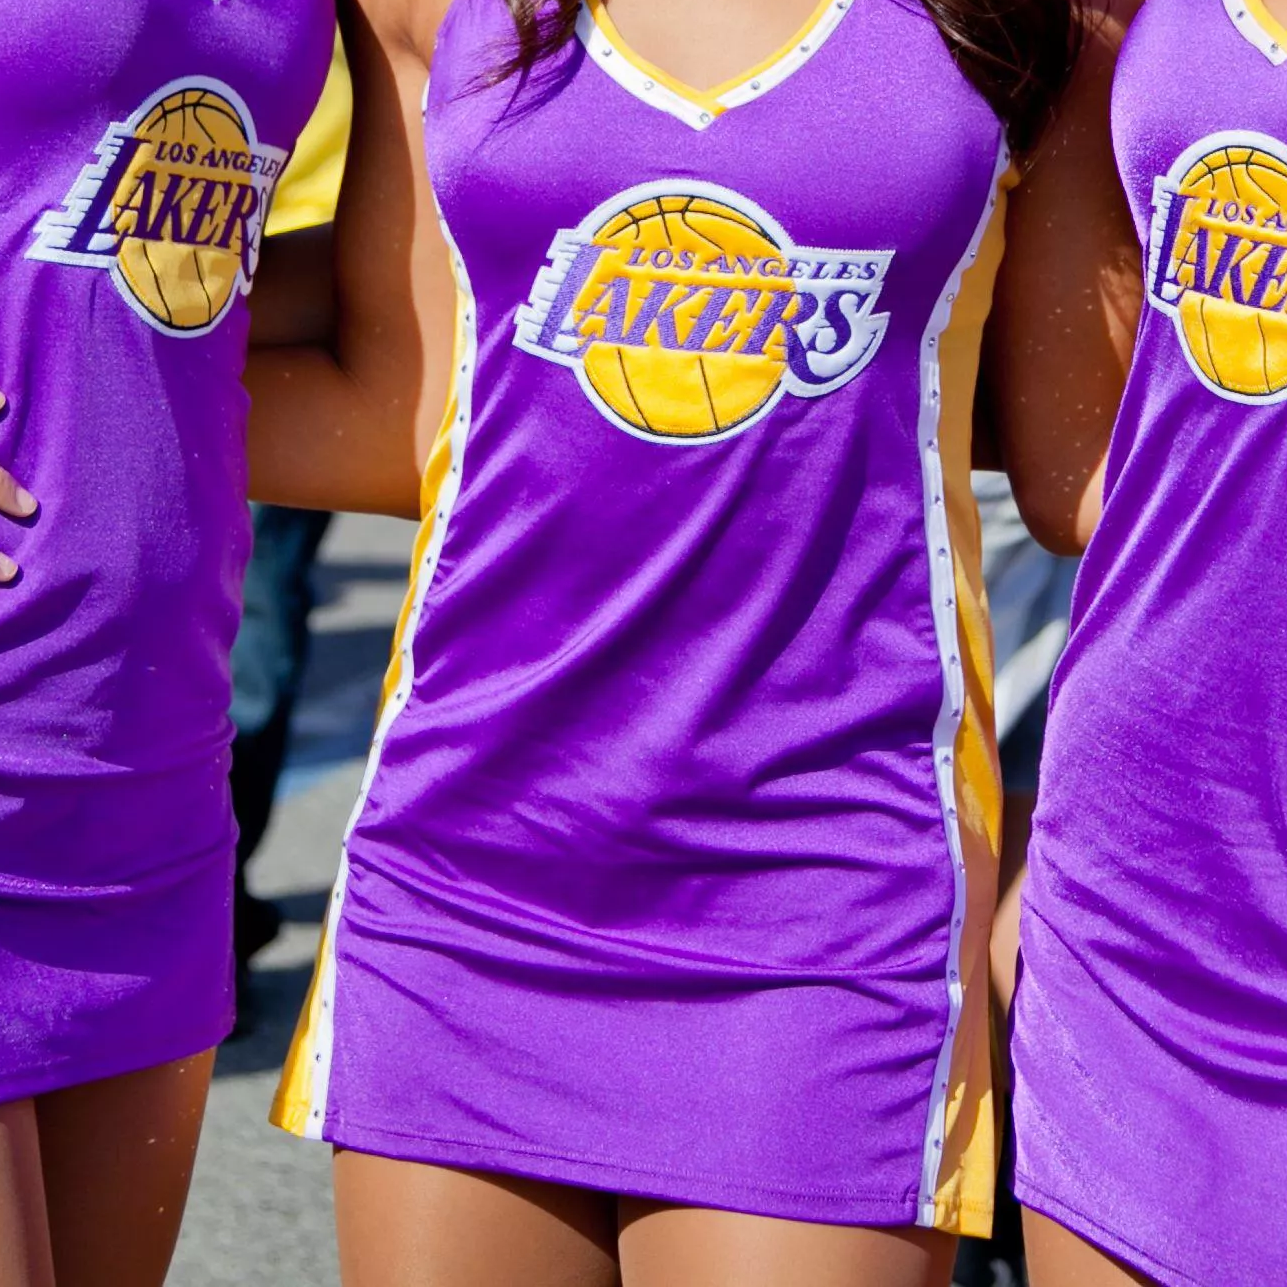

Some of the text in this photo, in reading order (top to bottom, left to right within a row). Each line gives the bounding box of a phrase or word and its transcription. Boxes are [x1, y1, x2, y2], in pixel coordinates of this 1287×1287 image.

[154, 141, 281, 179] LOS ANGELE
[65, 135, 269, 283] LAKER
[1206, 197, 1256, 225] LOS
[627, 246, 879, 281] LOS ANGELES
[537, 241, 879, 384] LAKERS
